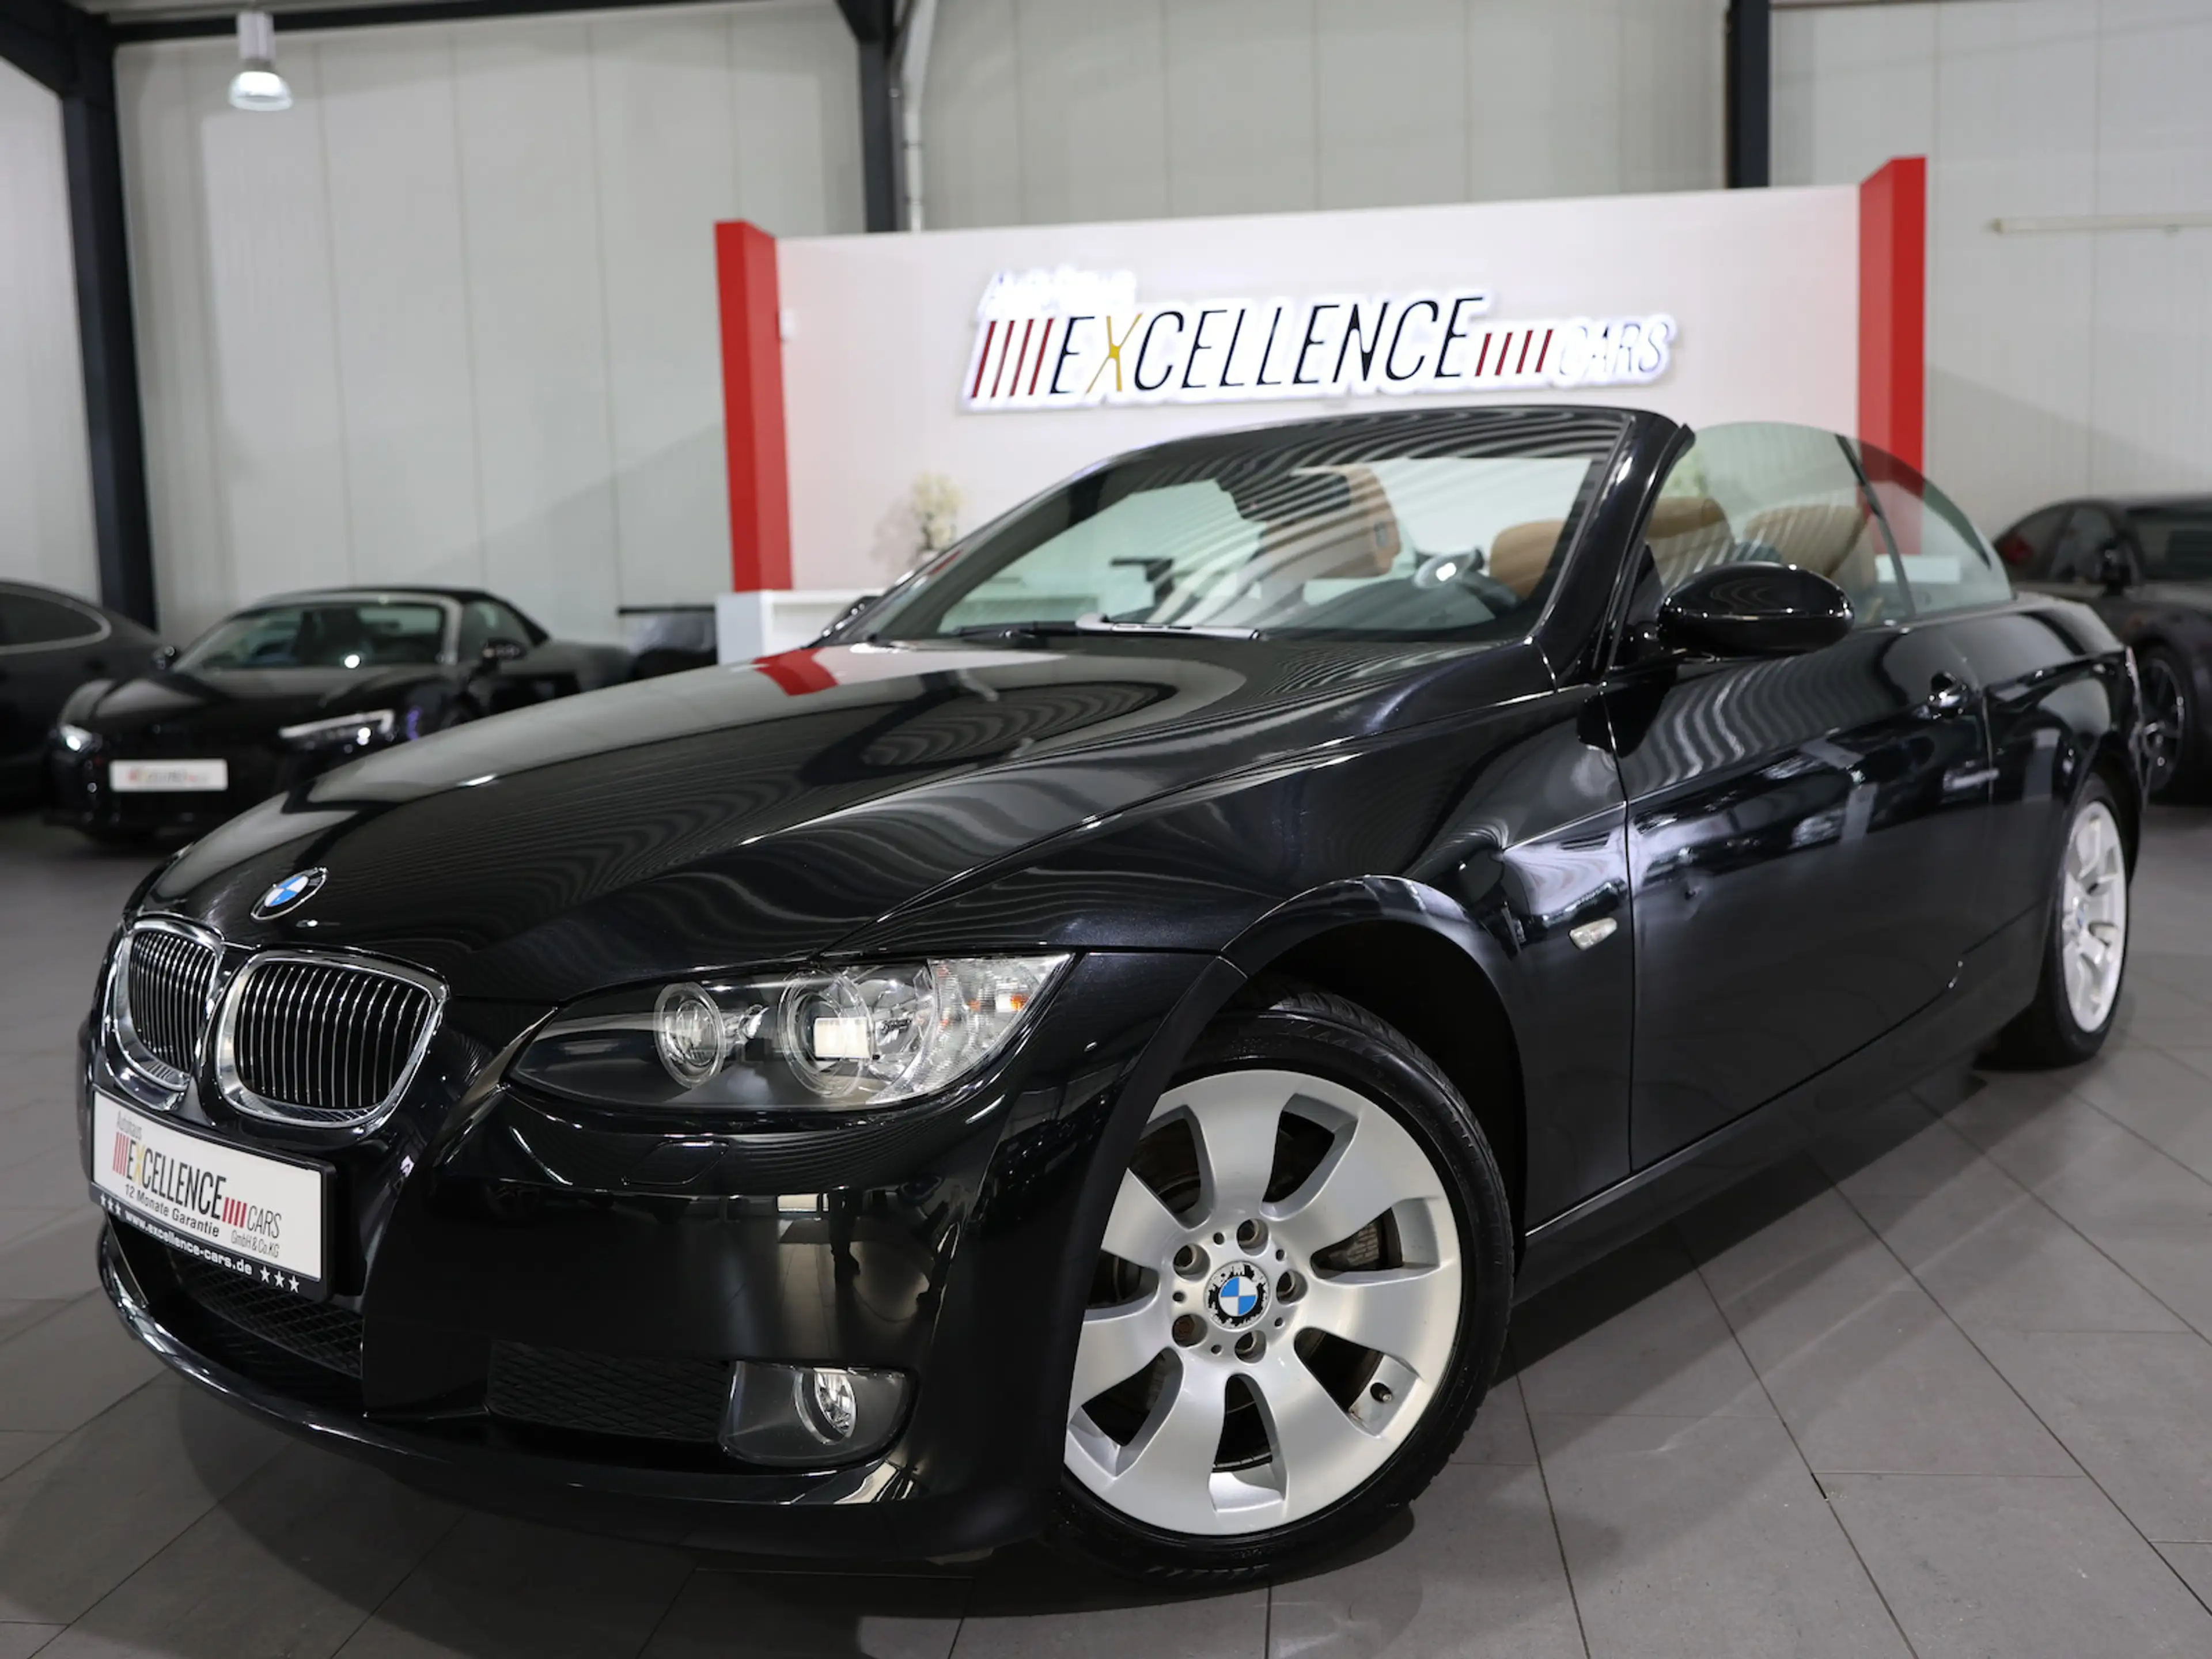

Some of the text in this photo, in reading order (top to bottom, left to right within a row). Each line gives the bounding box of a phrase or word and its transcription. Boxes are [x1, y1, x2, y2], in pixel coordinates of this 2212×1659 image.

[1048, 296, 1484, 395] EXCELLENCE
[125, 1184, 220, 1237] 12 Monate Garantie
[126, 1139, 282, 1239] EXCELLENCE CARS
[124, 1210, 253, 1276] www.excellence-cars.de
